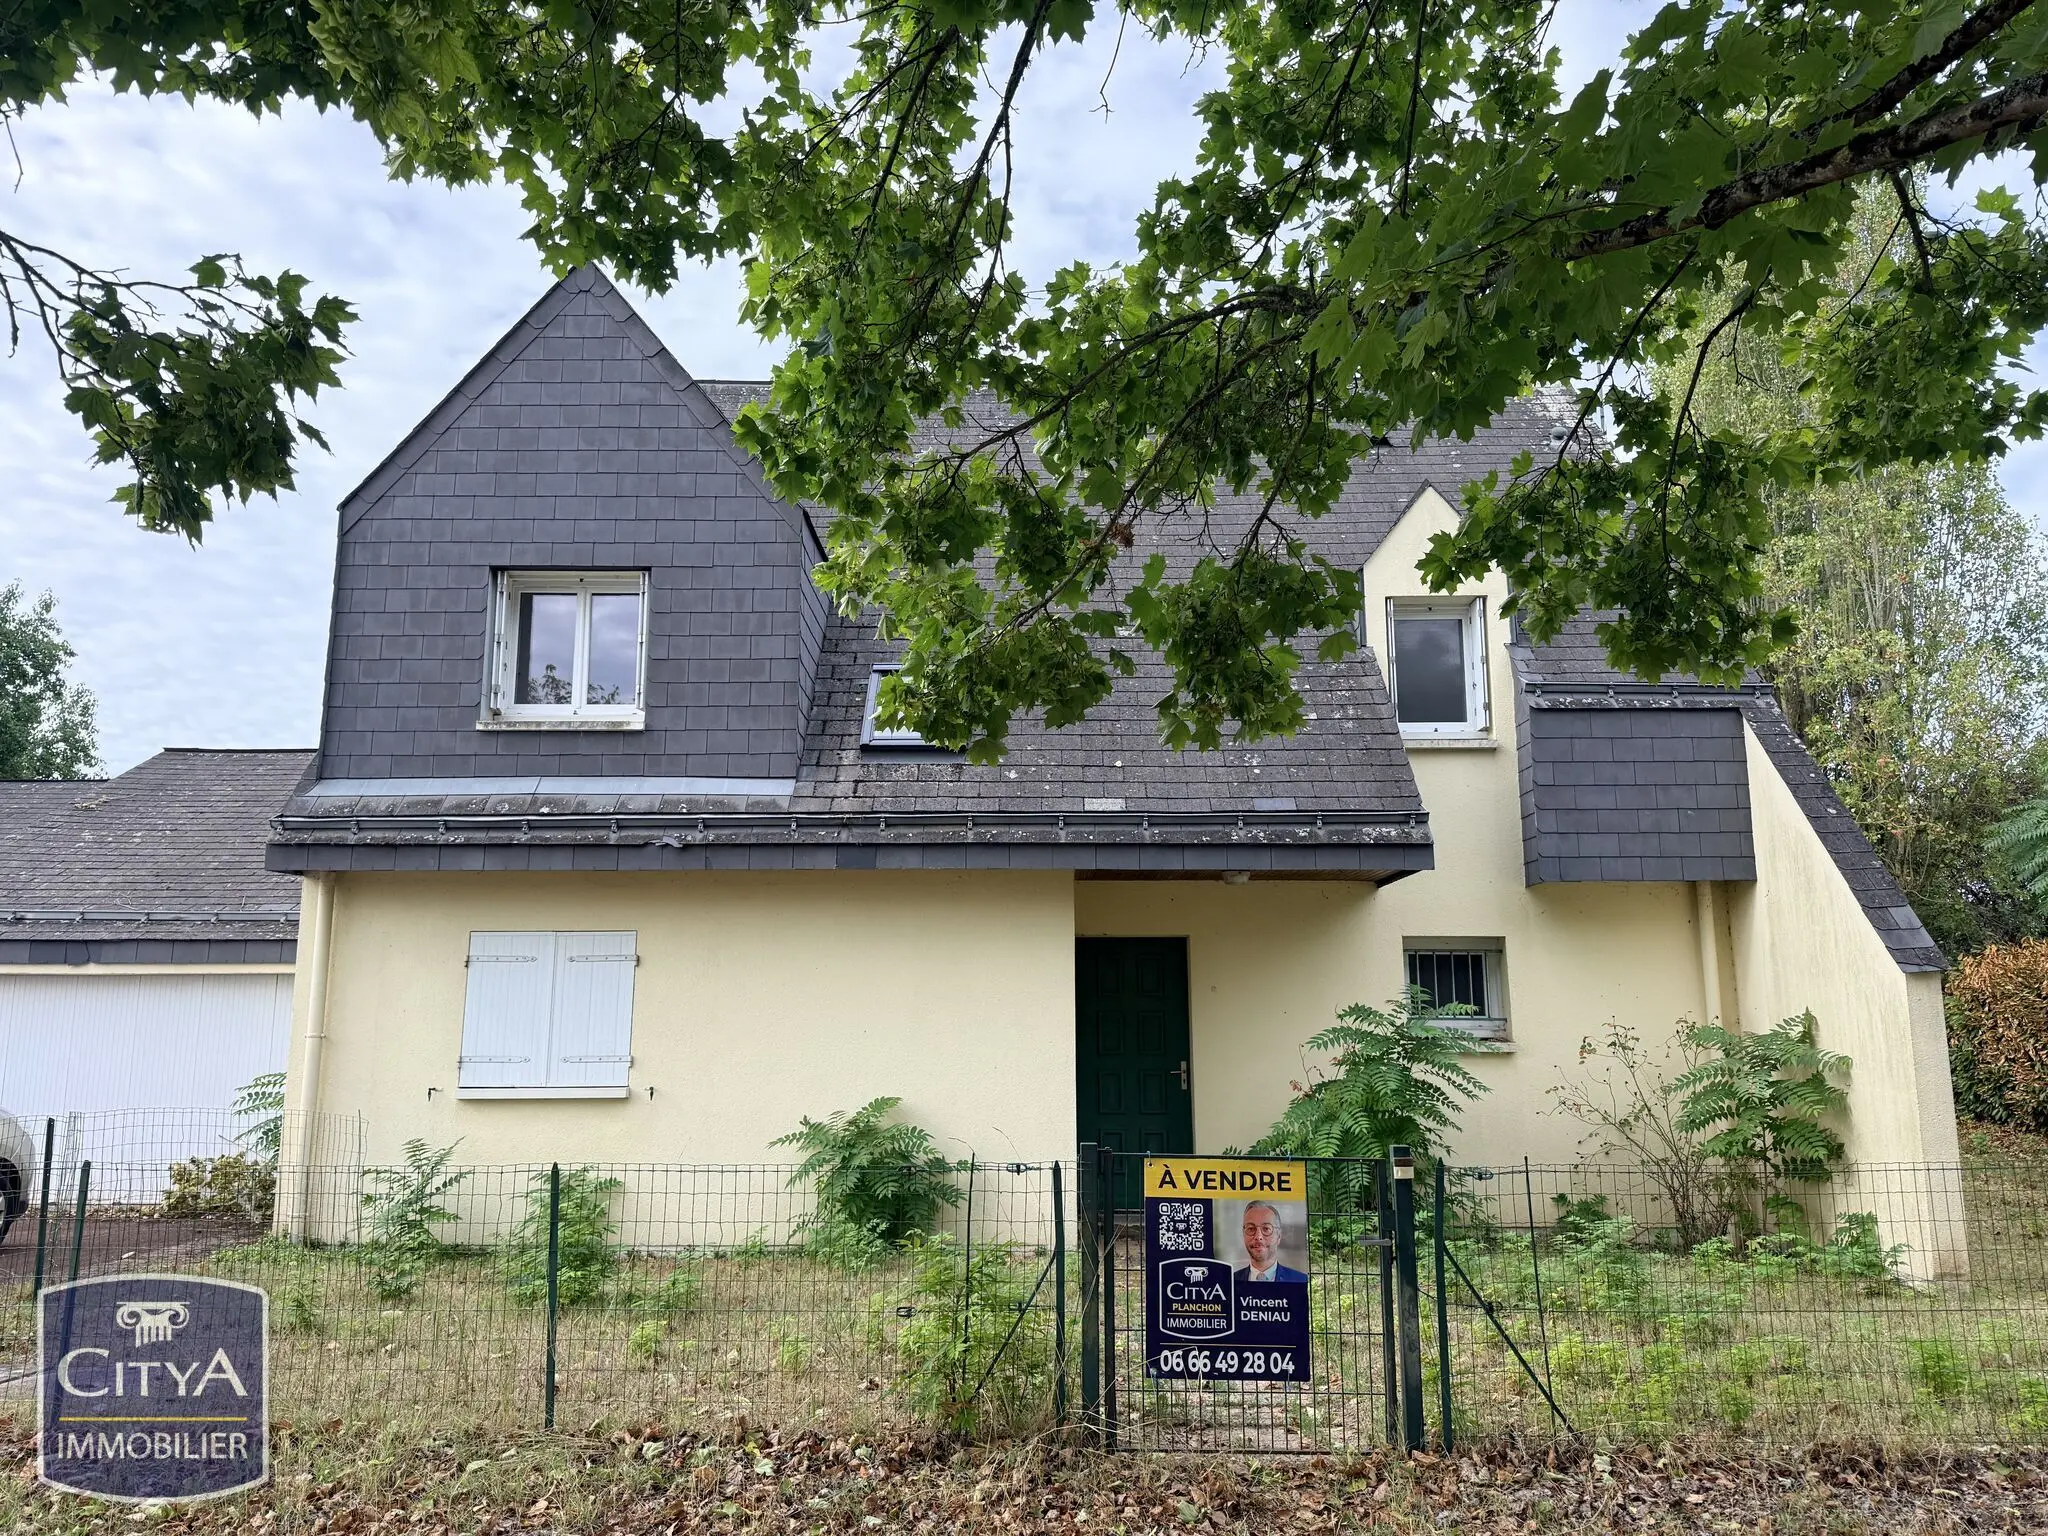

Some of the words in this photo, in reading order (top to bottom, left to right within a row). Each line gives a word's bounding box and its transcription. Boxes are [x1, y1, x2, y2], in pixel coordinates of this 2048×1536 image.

[1158, 1164, 1177, 1189] À
[1184, 1170, 1292, 1192] VENDRE
[1172, 1303, 1222, 1312] PLANCHON
[1240, 1296, 1288, 1308] Vincent
[1240, 1311, 1290, 1322] DENIAU
[1167, 1317, 1227, 1329] IMMOBILIER
[1160, 1350, 1184, 1372] 06
[1188, 1351, 1211, 1372] 66
[1215, 1351, 1239, 1373] 49
[1243, 1352, 1266, 1373] 28
[1270, 1352, 1295, 1374] 04
